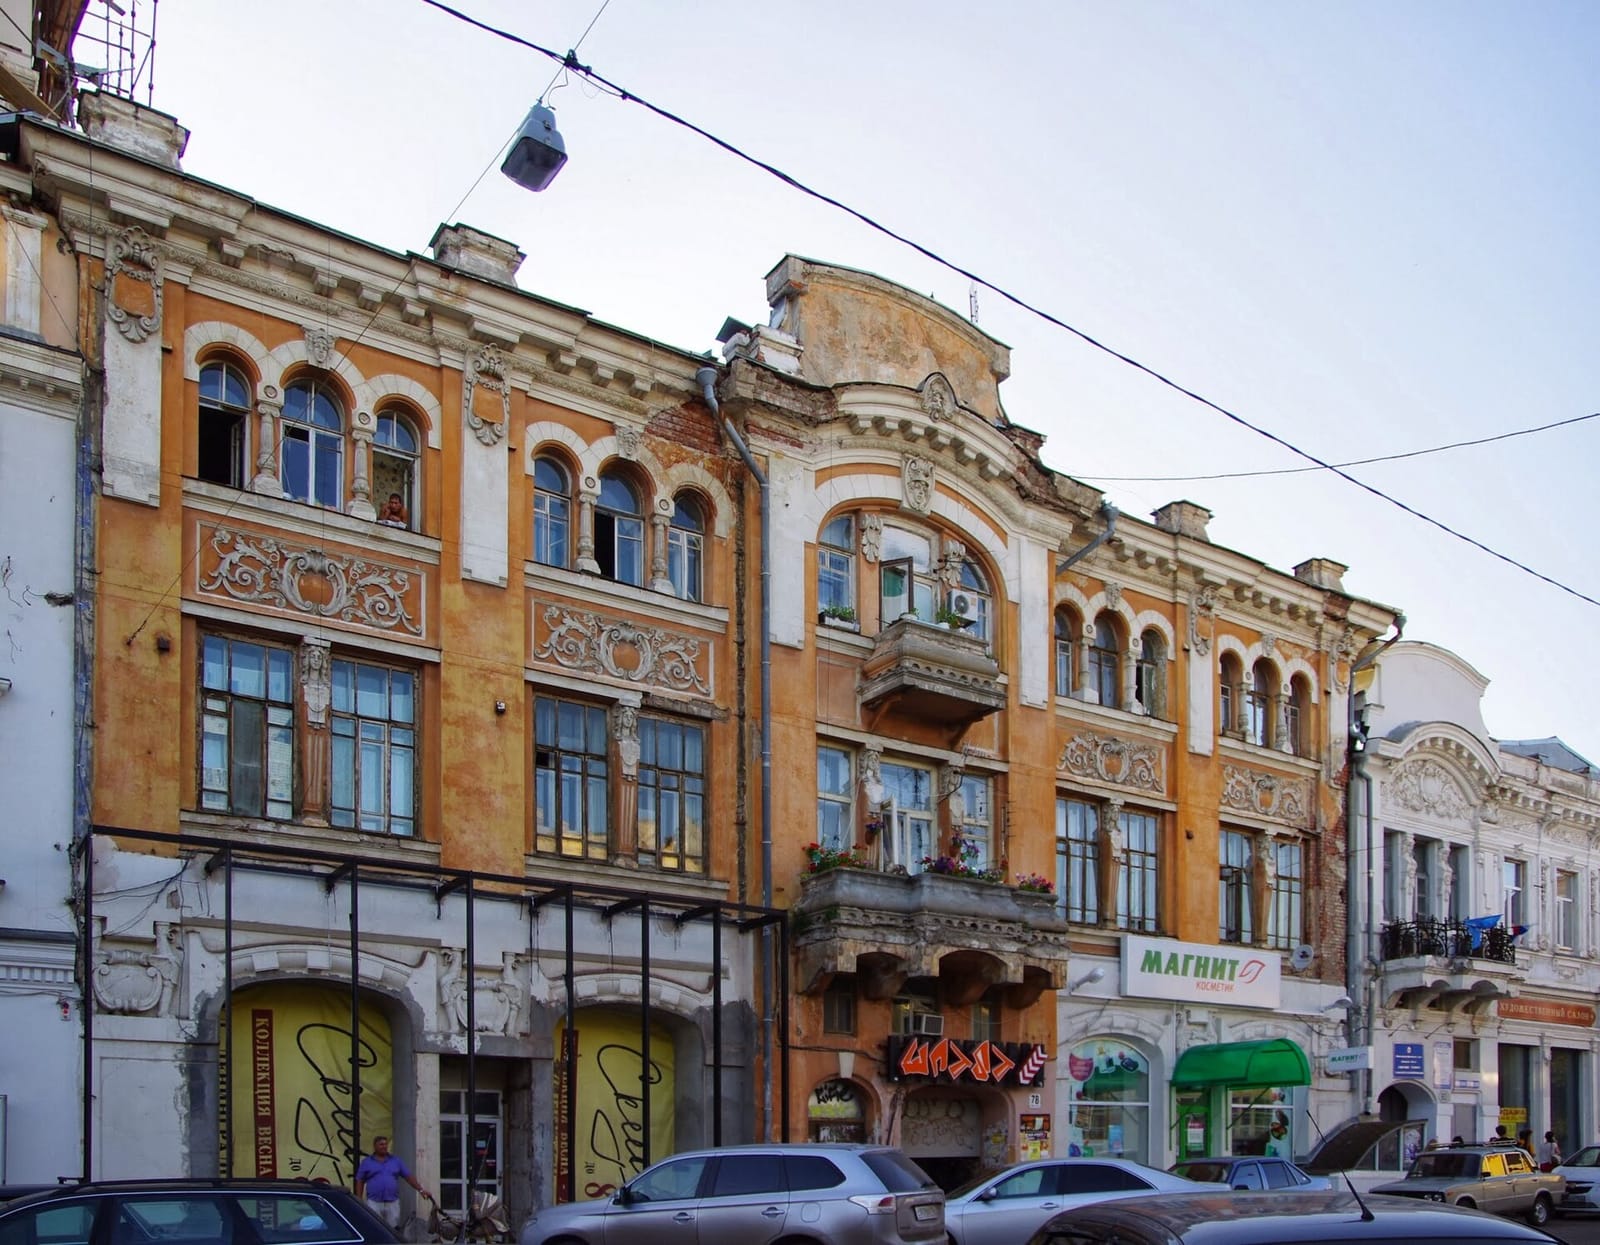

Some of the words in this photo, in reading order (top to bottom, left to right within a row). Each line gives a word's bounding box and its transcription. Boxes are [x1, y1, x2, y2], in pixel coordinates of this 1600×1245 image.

[1140, 950, 1240, 981] МАГНИТ
[1195, 980, 1235, 993] КОСМЕТИК
[1500, 1002, 1565, 1017] ХУДОЖЕСТВЕННЫЙ
[1567, 1010, 1589, 1020] САЛОН
[255, 1017, 272, 1117] КОЛЛЕКЦИЯ
[257, 1125, 273, 1176] ВЕСНА
